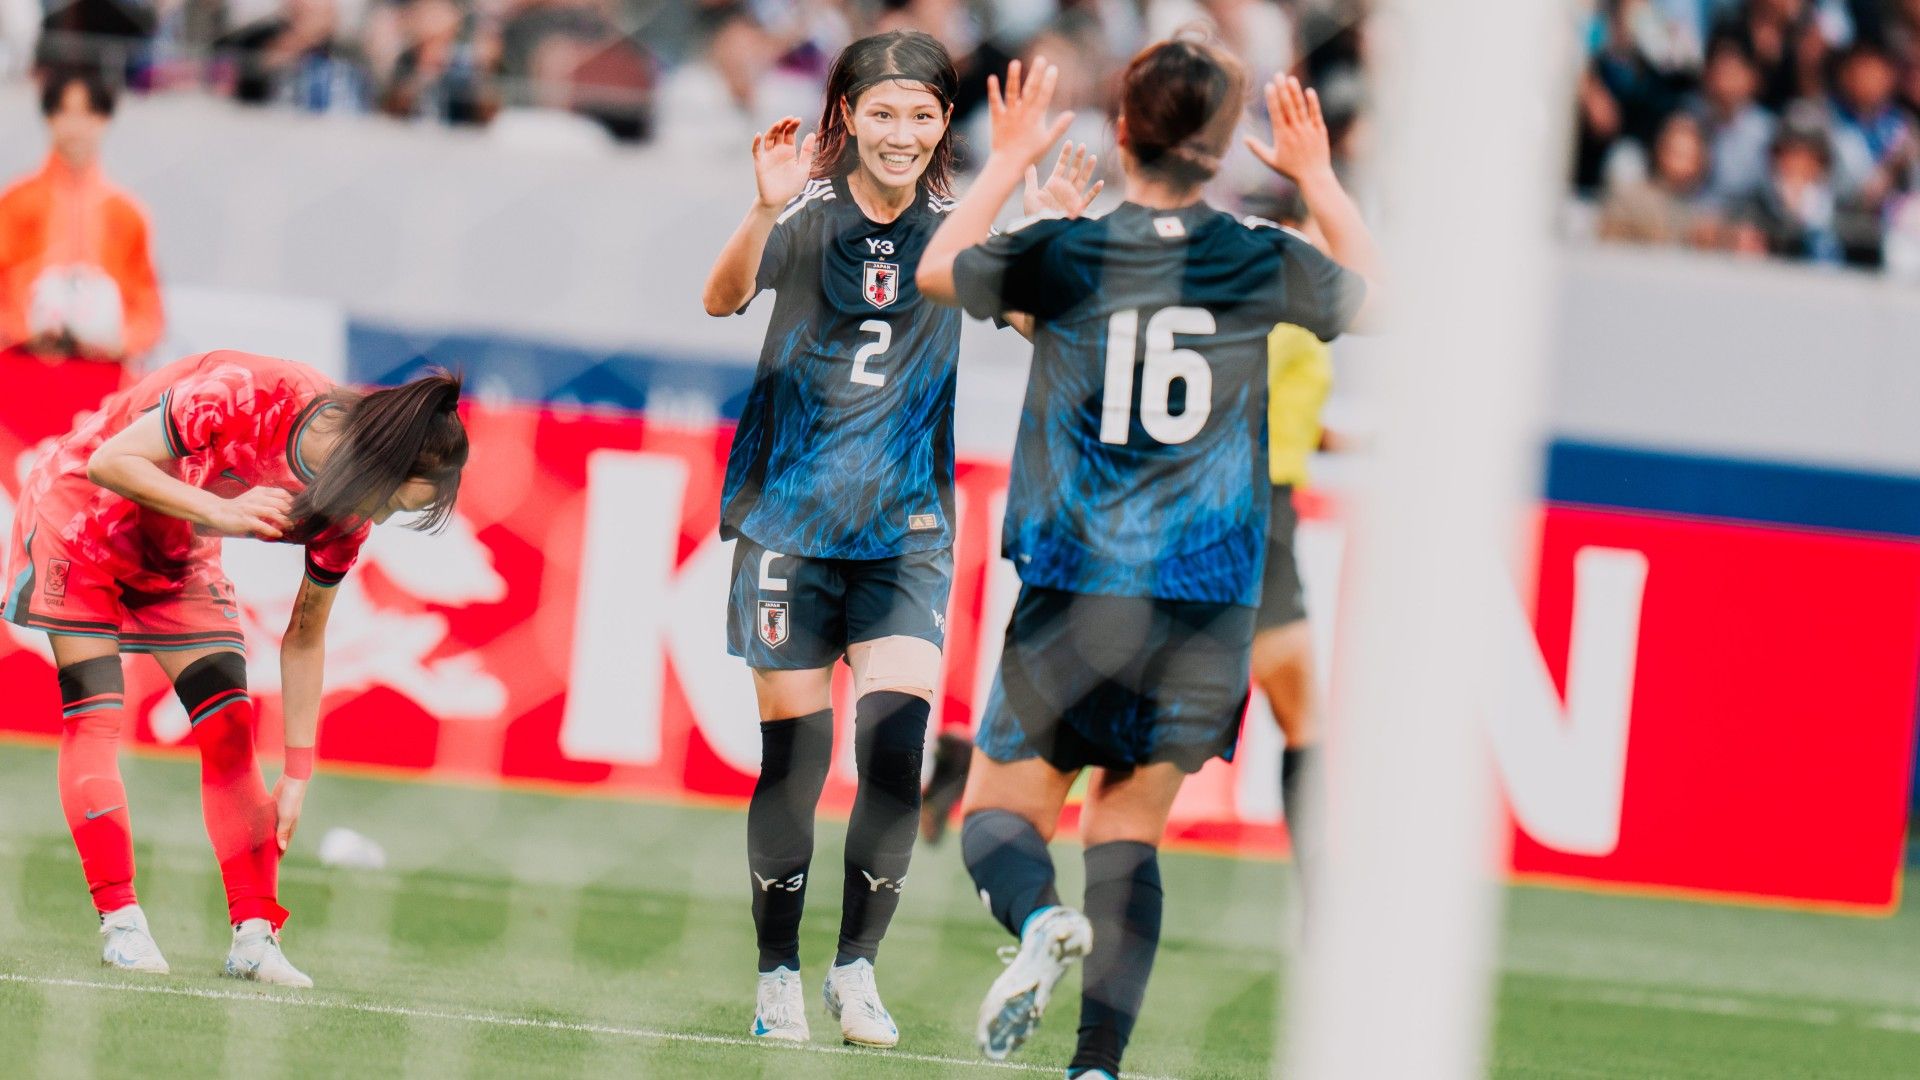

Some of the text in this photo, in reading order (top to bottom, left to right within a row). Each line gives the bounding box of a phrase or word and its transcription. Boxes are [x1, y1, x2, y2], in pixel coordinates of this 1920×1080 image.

[865, 237, 895, 255] Y-3
[872, 293, 888, 301] JFA
[849, 319, 892, 387] 2
[1100, 306, 1216, 445] 16
[557, 448, 1649, 856] KIN
[753, 871, 804, 893] Y-3
[861, 869, 908, 894] Y-3
